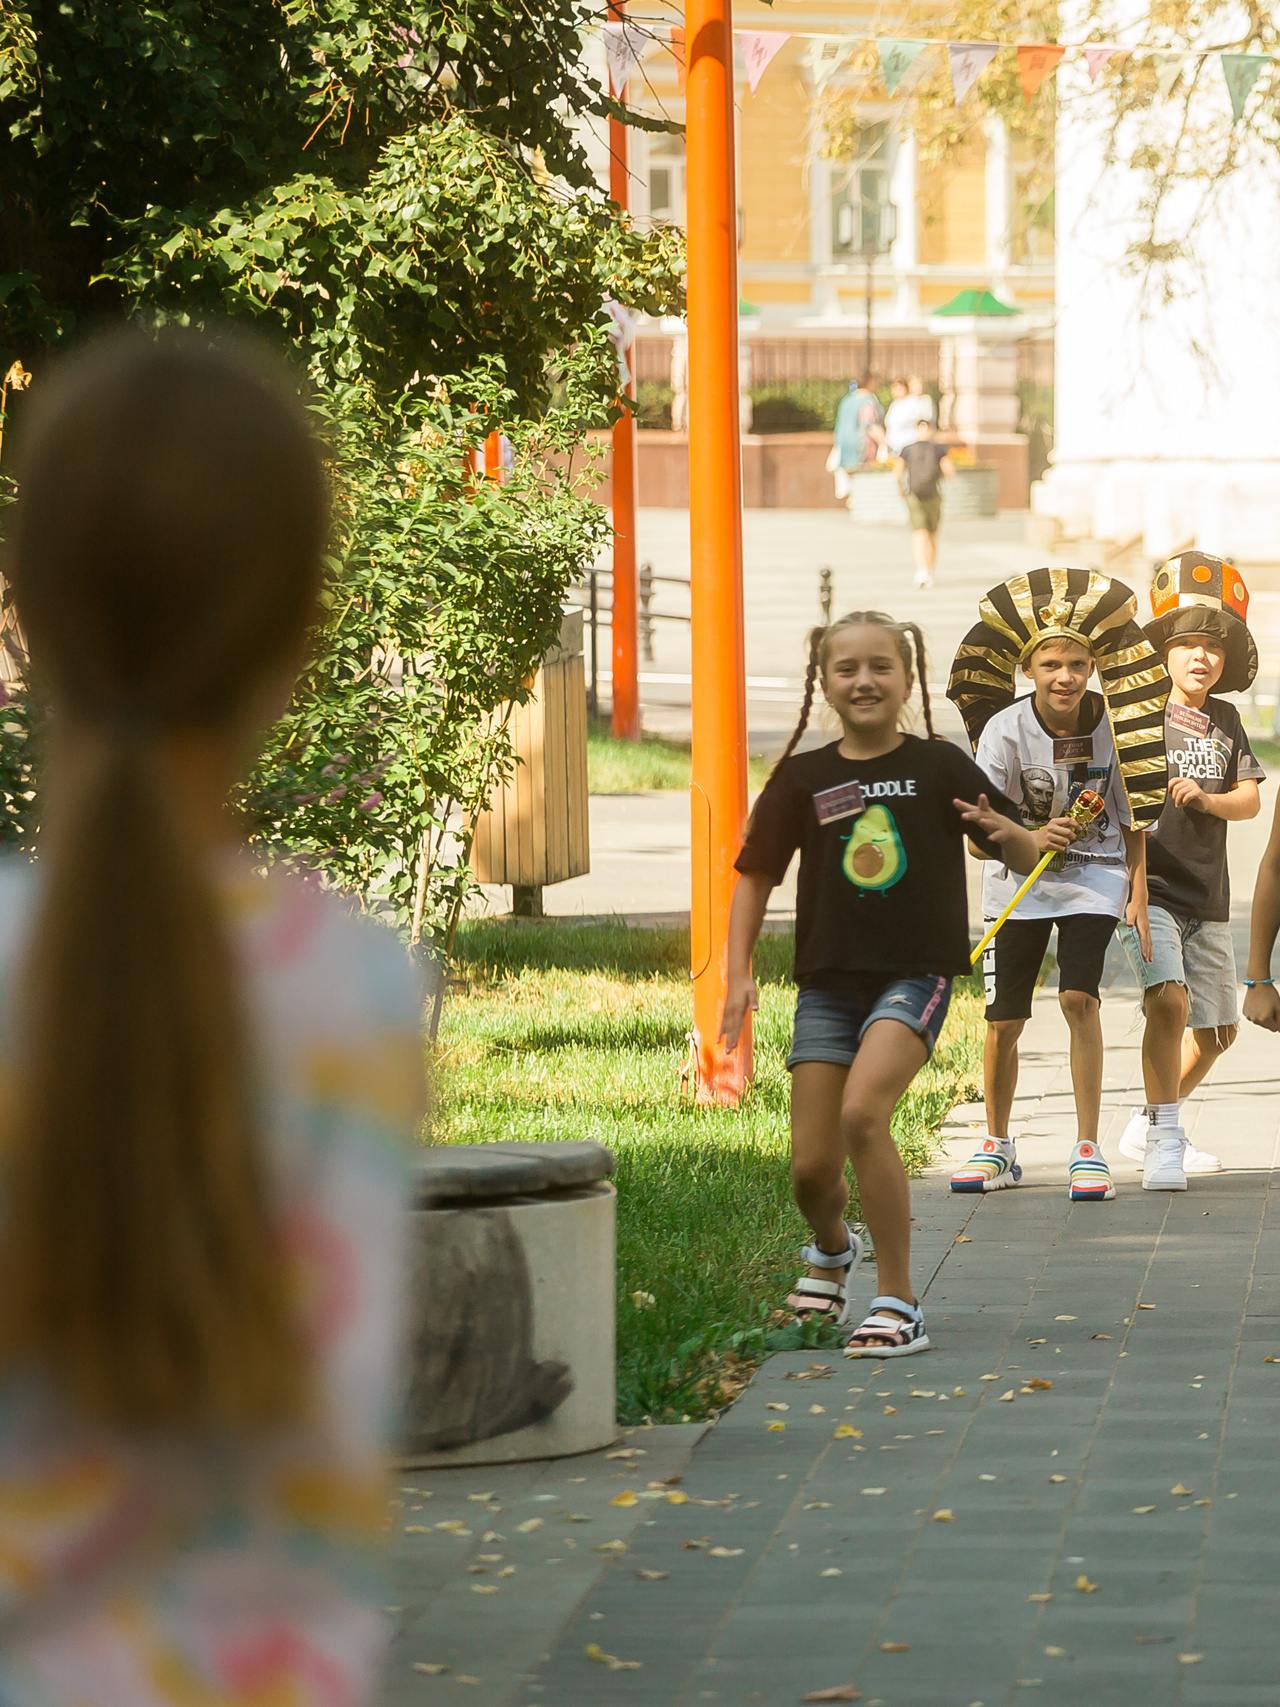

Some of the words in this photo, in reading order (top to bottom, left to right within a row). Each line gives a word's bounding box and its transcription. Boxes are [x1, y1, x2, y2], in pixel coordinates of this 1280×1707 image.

[1183, 738, 1214, 752] THE
[1166, 749, 1216, 765] NORTH
[1179, 763, 1216, 779] FACE
